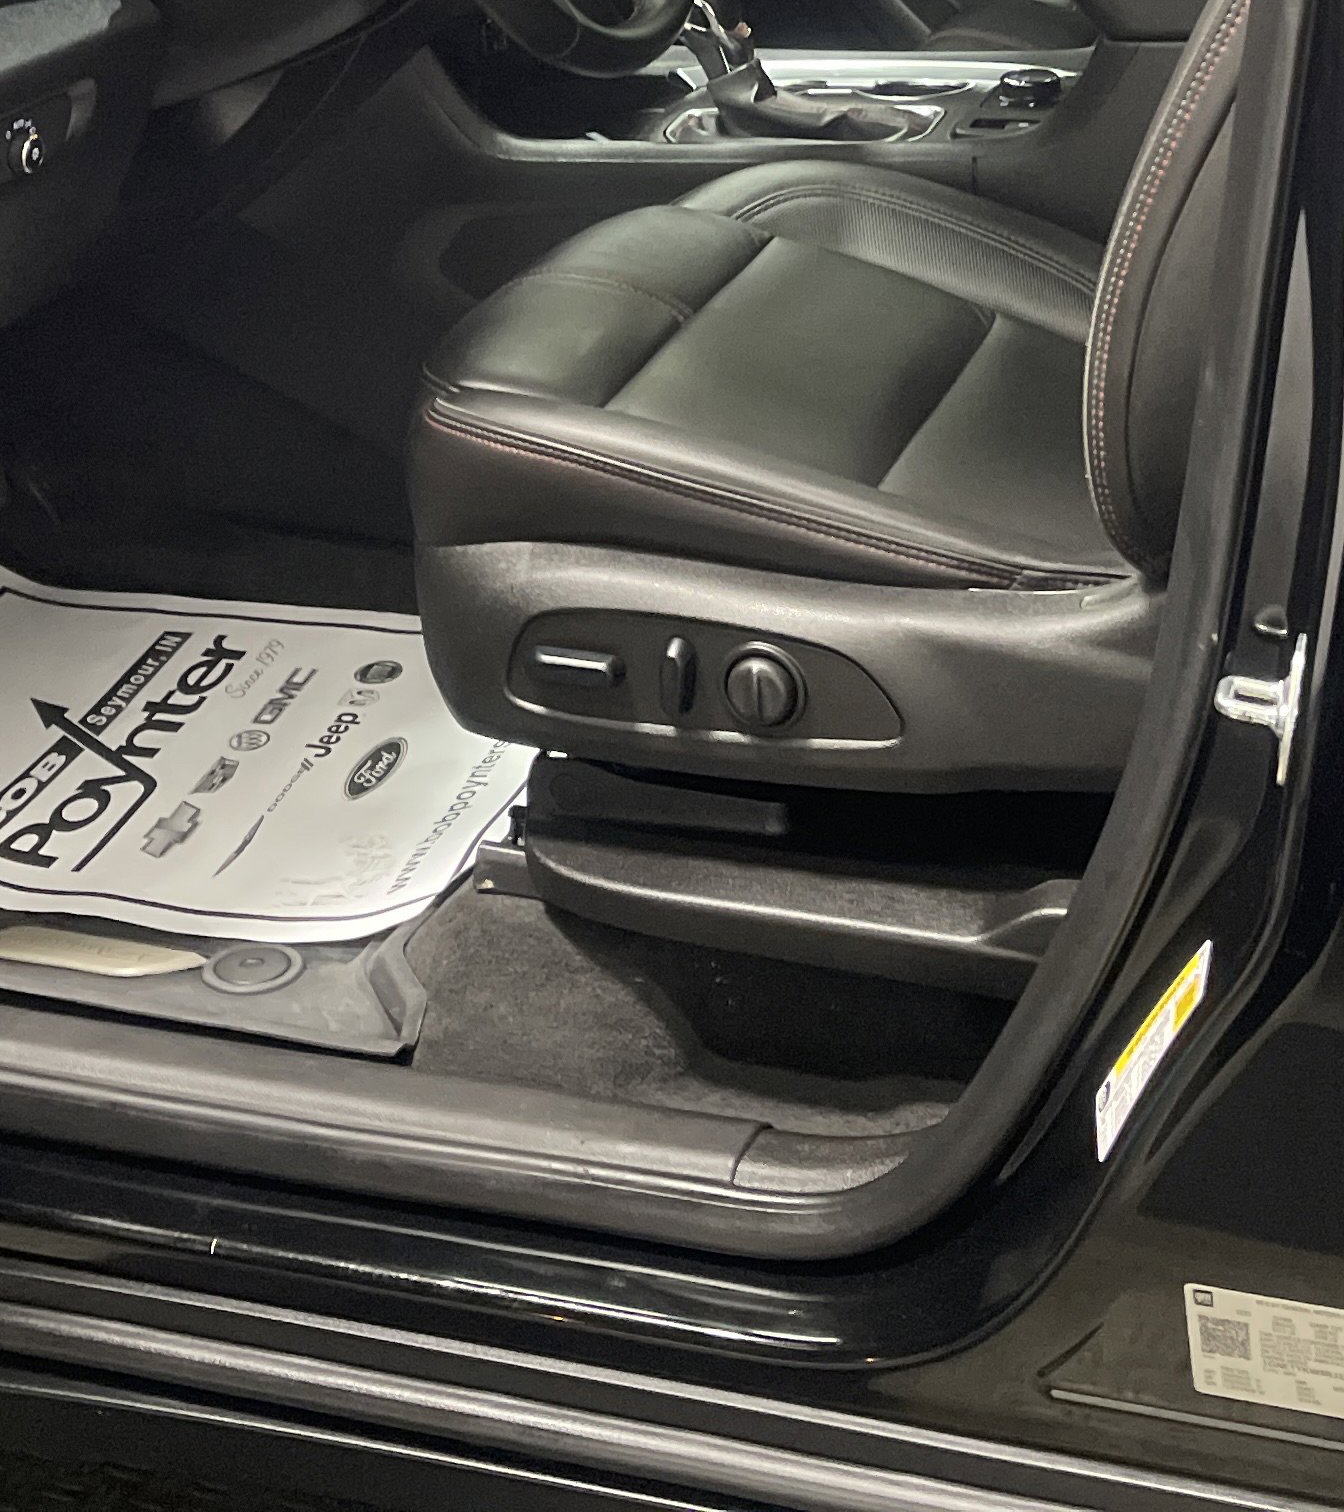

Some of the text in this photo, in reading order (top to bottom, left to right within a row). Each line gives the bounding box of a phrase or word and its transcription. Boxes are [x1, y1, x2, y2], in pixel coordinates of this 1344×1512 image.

[154, 635, 183, 652] IN
[256, 639, 285, 668] 1979
[253, 667, 319, 725] GMC
[305, 712, 361, 758] Jeep
[354, 750, 397, 788] Ford
